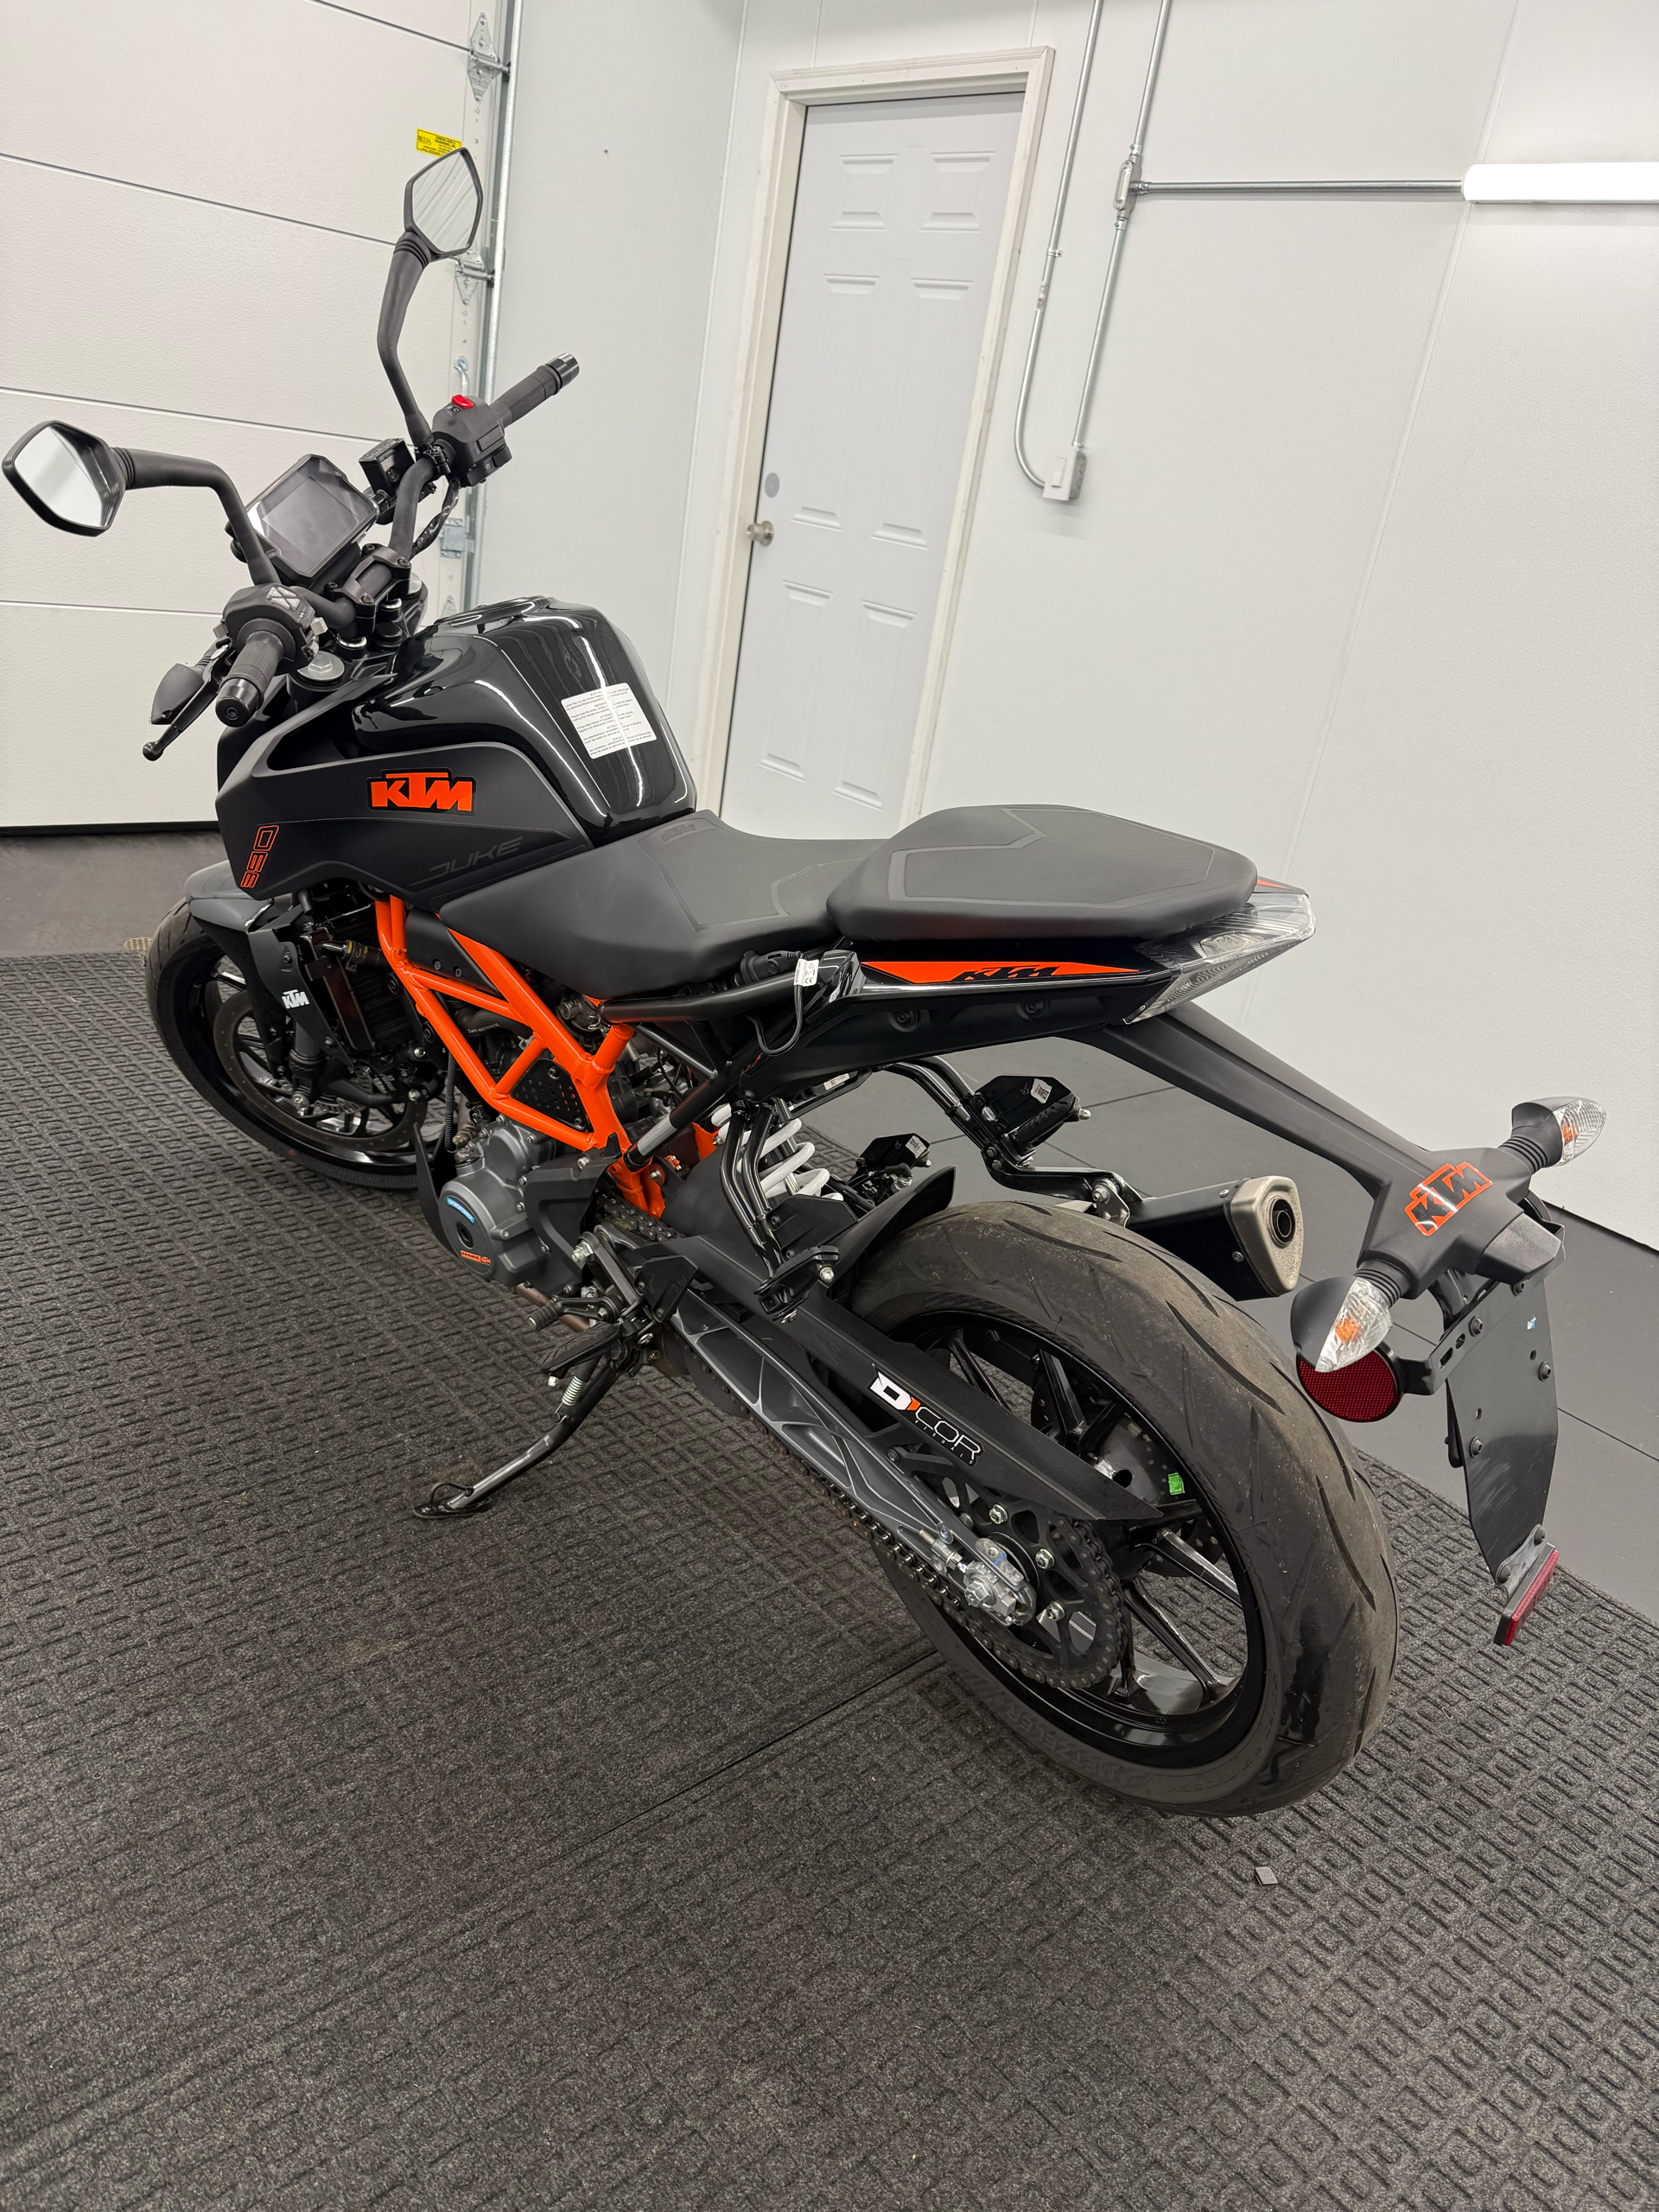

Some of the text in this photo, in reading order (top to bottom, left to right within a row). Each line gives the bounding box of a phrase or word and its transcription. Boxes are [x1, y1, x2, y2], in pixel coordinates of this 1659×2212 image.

[371, 772, 473, 811] KTM
[240, 825, 279, 888] 390
[428, 836, 523, 876] DUKE
[282, 989, 309, 1009] KTM
[1412, 1167, 1488, 1232] KTM
